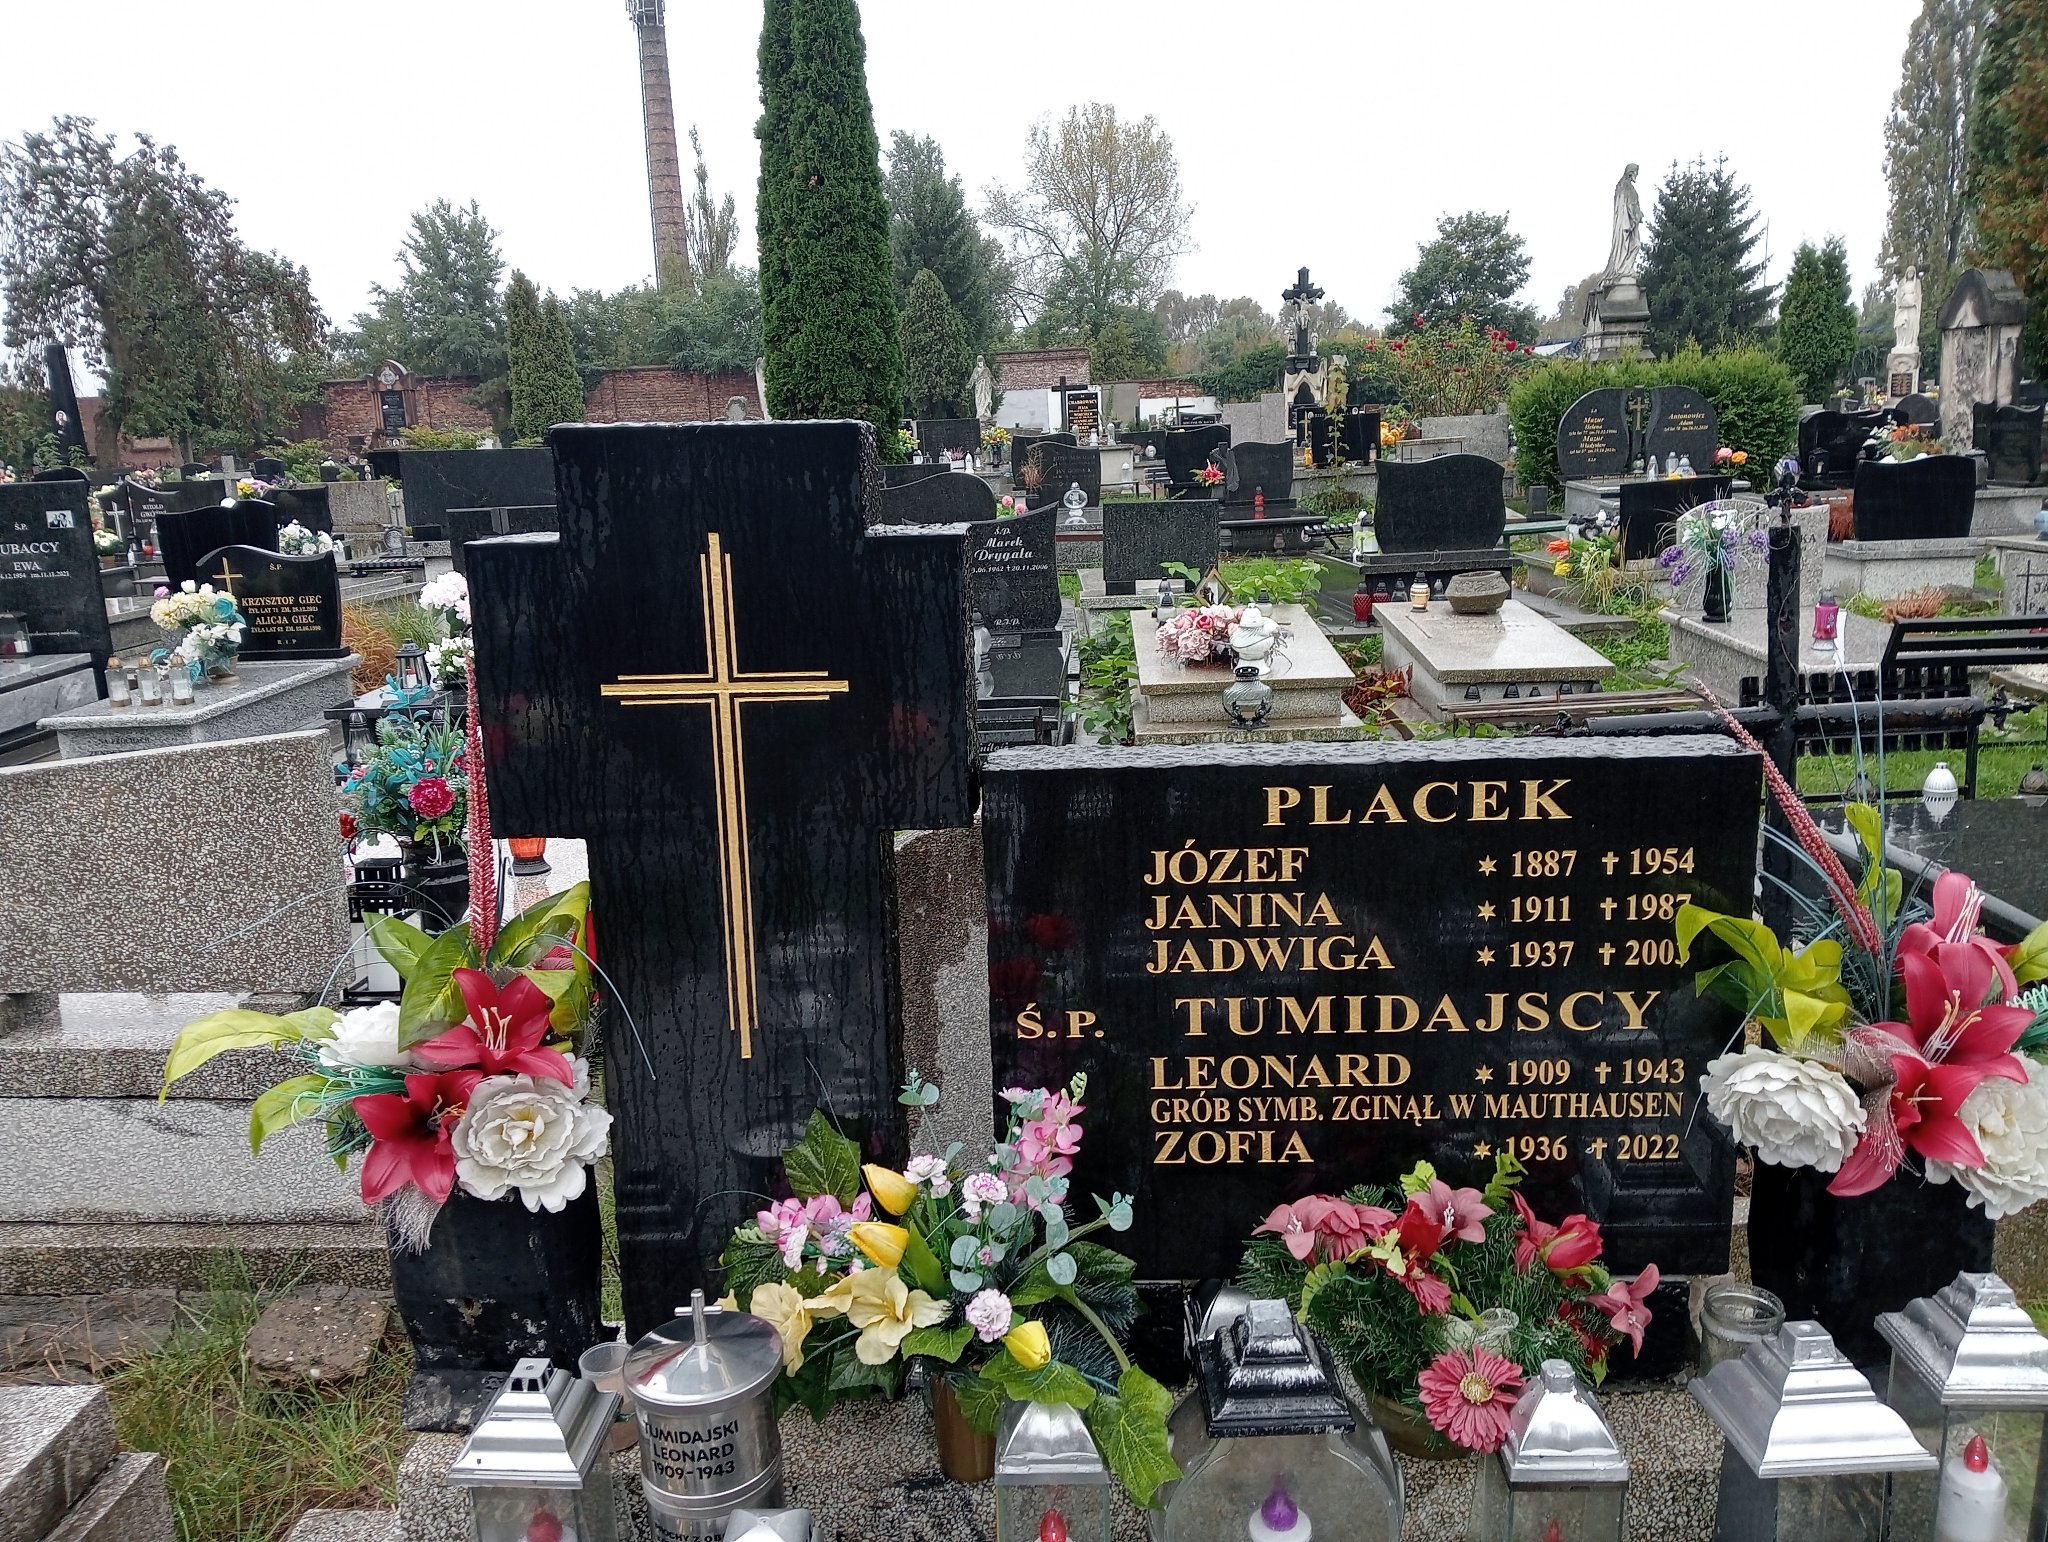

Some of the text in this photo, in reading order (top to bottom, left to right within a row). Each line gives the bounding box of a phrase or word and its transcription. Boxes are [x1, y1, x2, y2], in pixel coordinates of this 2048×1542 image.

[0, 542, 60, 555] UBACCY
[983, 536, 1023, 548] Marek
[13, 561, 42, 571] EWA
[241, 595, 322, 607] KRZYSZTOF GIEC
[255, 614, 315, 625] ALICJA GIEC
[1264, 779, 1571, 826] PLACEK
[1143, 838, 1695, 886] JÓZEF 1887 1954
[1144, 892, 1343, 930] JANINA
[1509, 895, 1572, 922] 1911
[1145, 935, 1683, 974] JADWIGA 1937 200
[1175, 990, 1660, 1036] TUMIDAJSCY
[1151, 1053, 1685, 1090] LEONARD 1909 1943
[1150, 1091, 1684, 1127] GRÓB SYMB. ZGINĄŁ W MAUTHAUSEN
[1154, 1130, 1680, 1164] ZOFIA 1936 2022
[642, 1420, 739, 1444] TUMIDAJSKI
[653, 1443, 735, 1463] LEONARD
